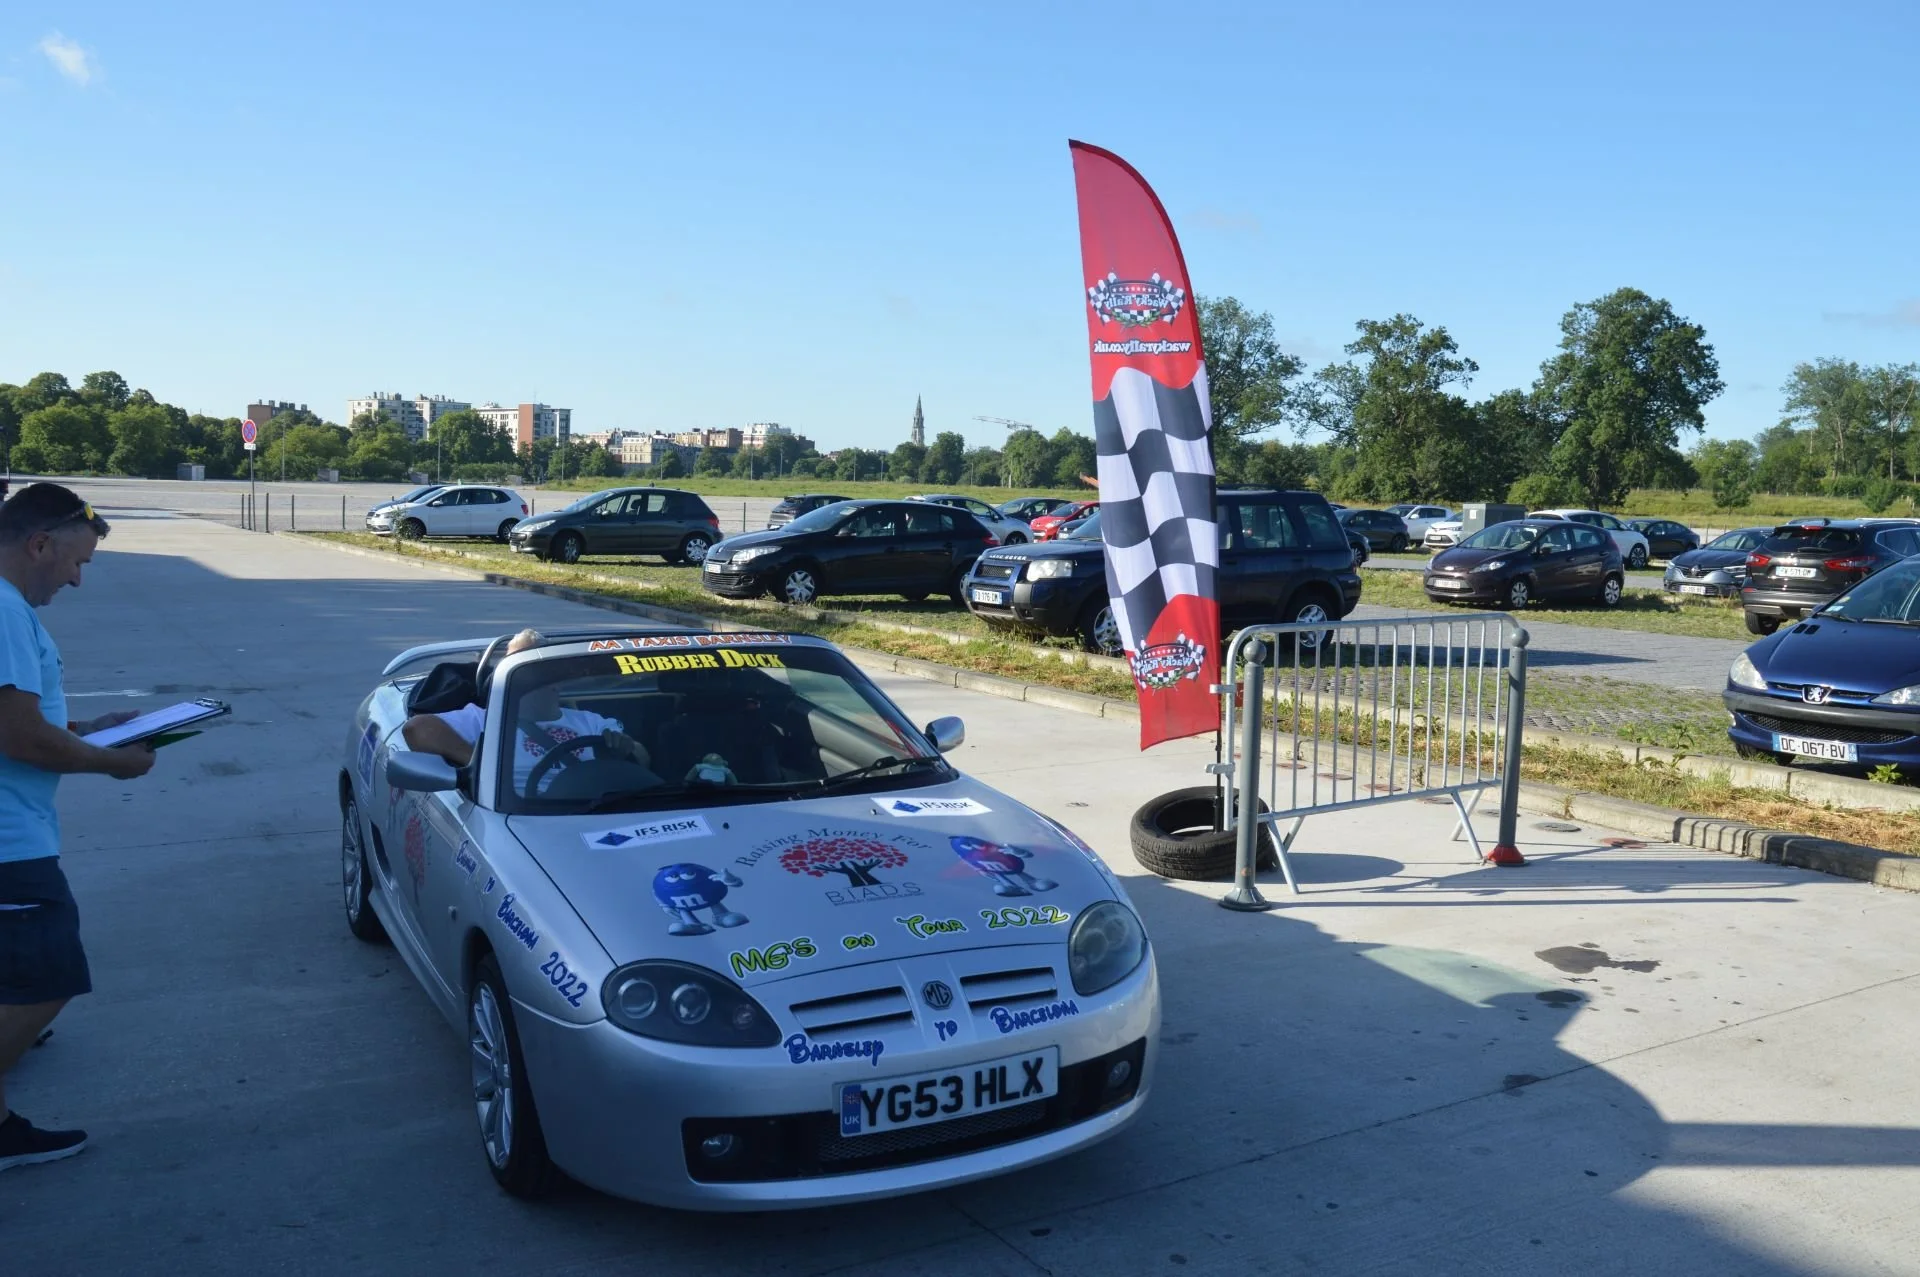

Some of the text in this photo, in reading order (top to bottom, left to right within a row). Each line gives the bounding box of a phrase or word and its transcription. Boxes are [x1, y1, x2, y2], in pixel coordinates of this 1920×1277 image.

[589, 633, 791, 652] AA TAXIS BARNSLEY
[920, 801, 974, 810] IFS RISK
[634, 825, 659, 837] IFS
[662, 820, 699, 833] RISK
[735, 827, 933, 867] Raising Money For
[825, 881, 921, 904] BIADS
[981, 906, 1069, 929] 2022
[540, 951, 588, 1007] 2022
[925, 986, 951, 1004] MG
[861, 1057, 1044, 1127] YG53 HLX
[844, 1115, 860, 1125] UK
